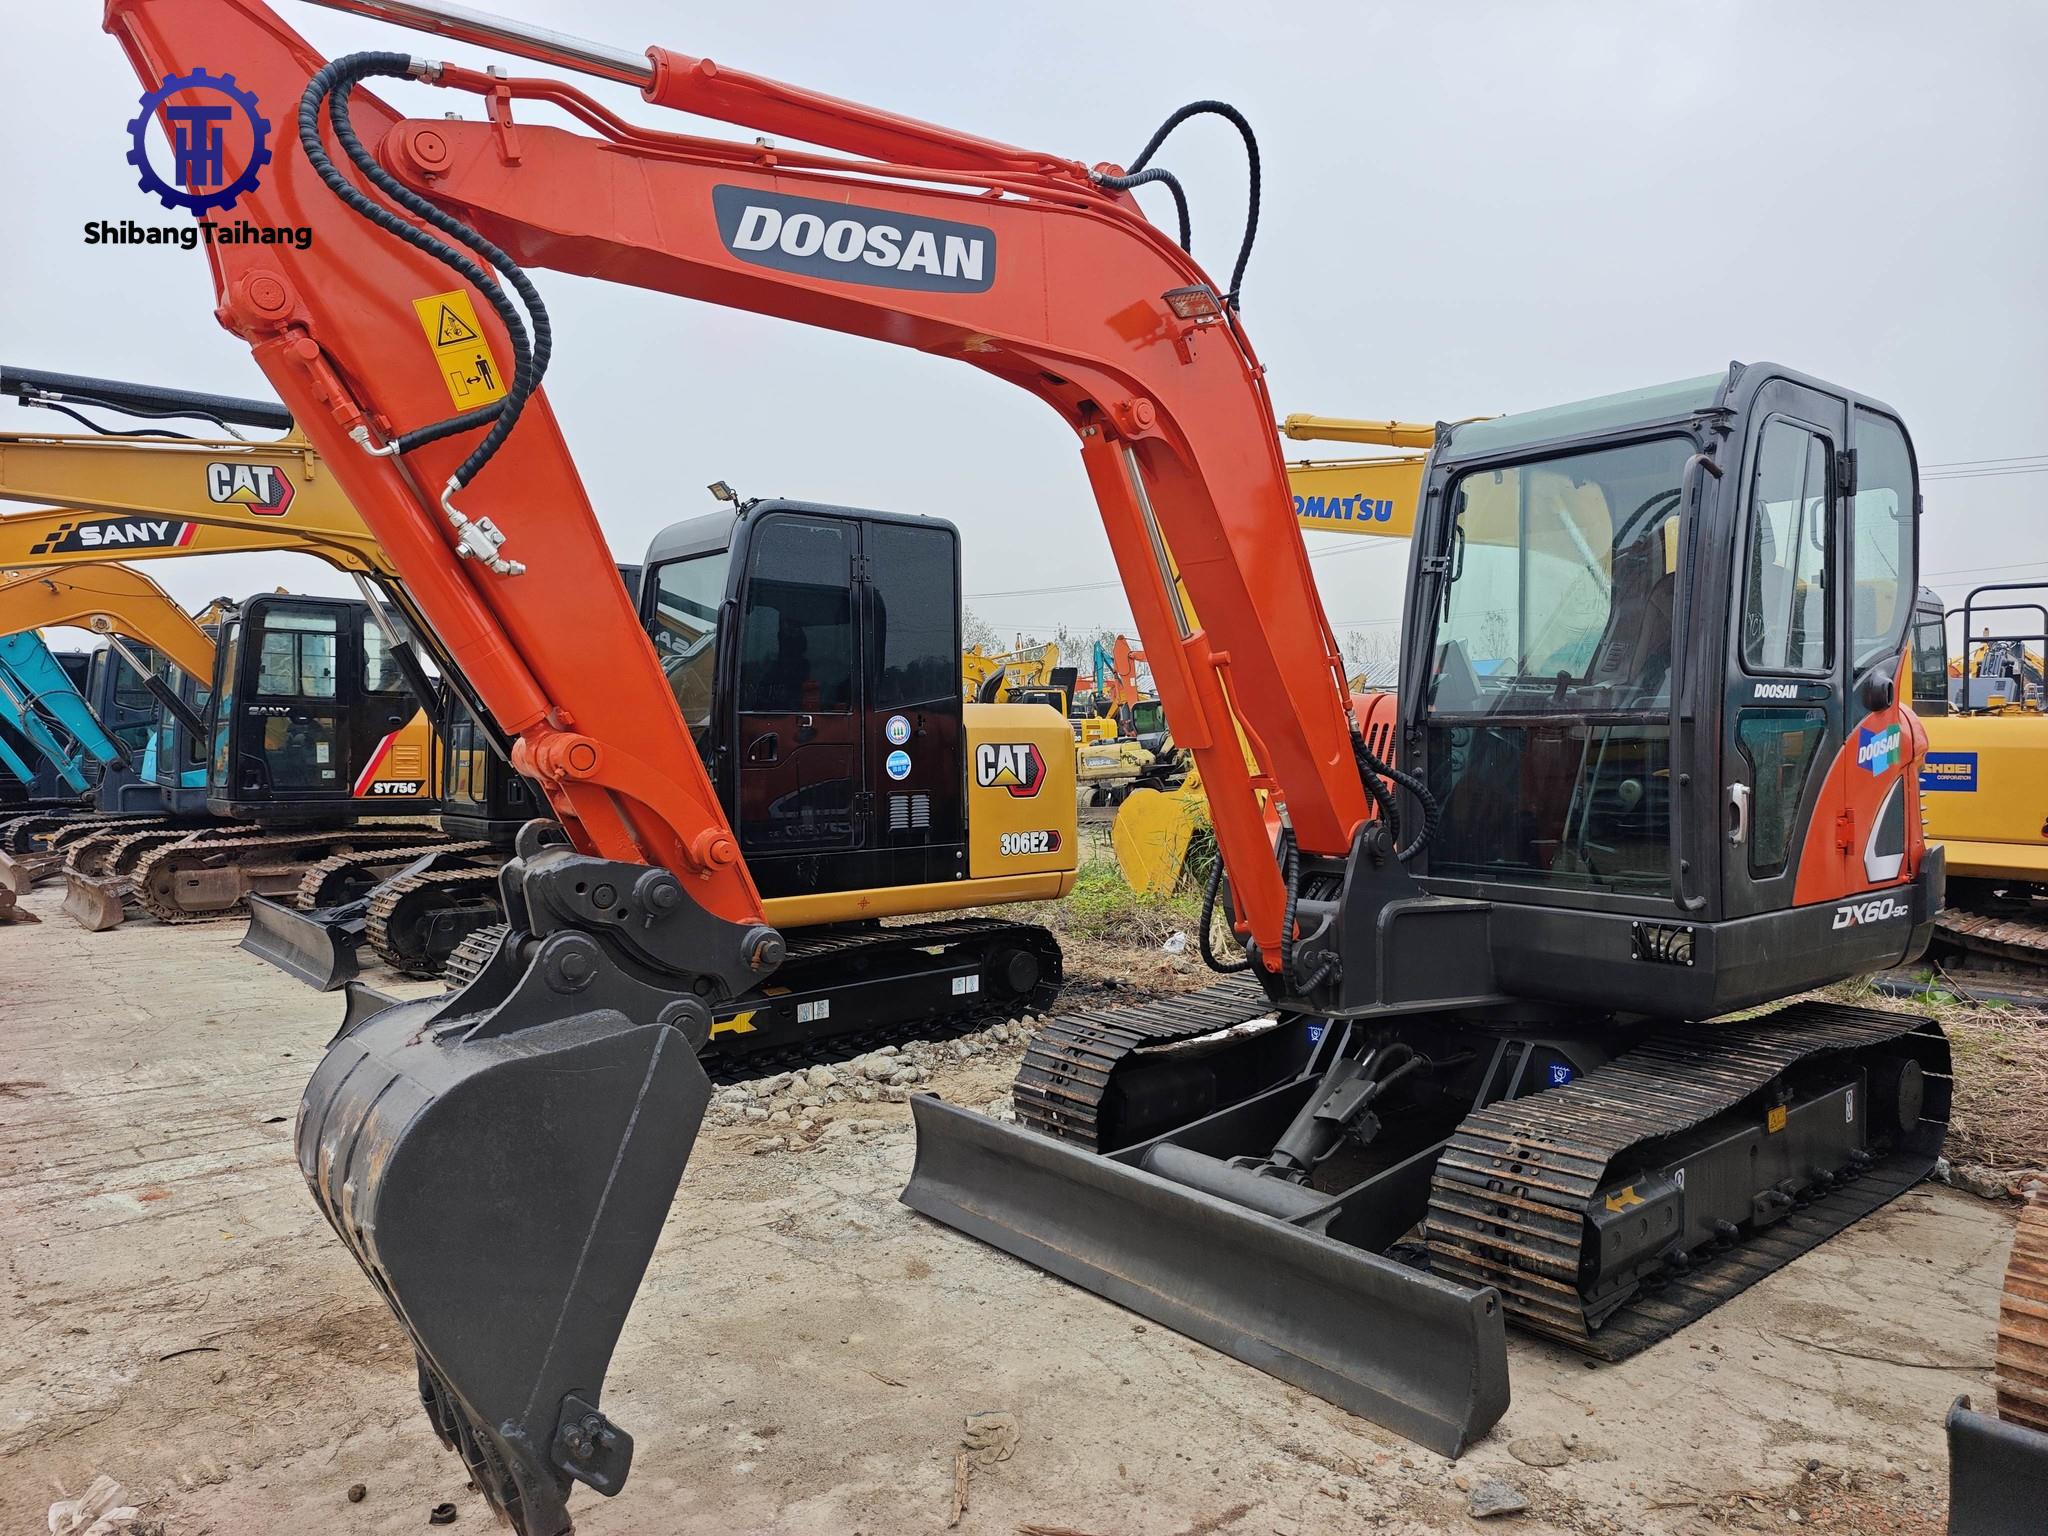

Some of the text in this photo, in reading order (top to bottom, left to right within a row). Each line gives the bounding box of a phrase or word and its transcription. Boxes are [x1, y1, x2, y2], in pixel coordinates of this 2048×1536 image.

[732, 205, 984, 281] DOOSAN
[209, 463, 273, 503] CAT
[1293, 493, 1393, 522] OMATSU
[79, 521, 169, 547] SANY
[1754, 684, 1798, 698] DOOSAN
[248, 706, 291, 716] SANY
[1858, 732, 1900, 764] DOOSAN
[977, 744, 1030, 786] CAT
[374, 782, 417, 794] SY75C
[1000, 831, 1049, 855] 306E2
[1832, 898, 1909, 930] DX60-9C
